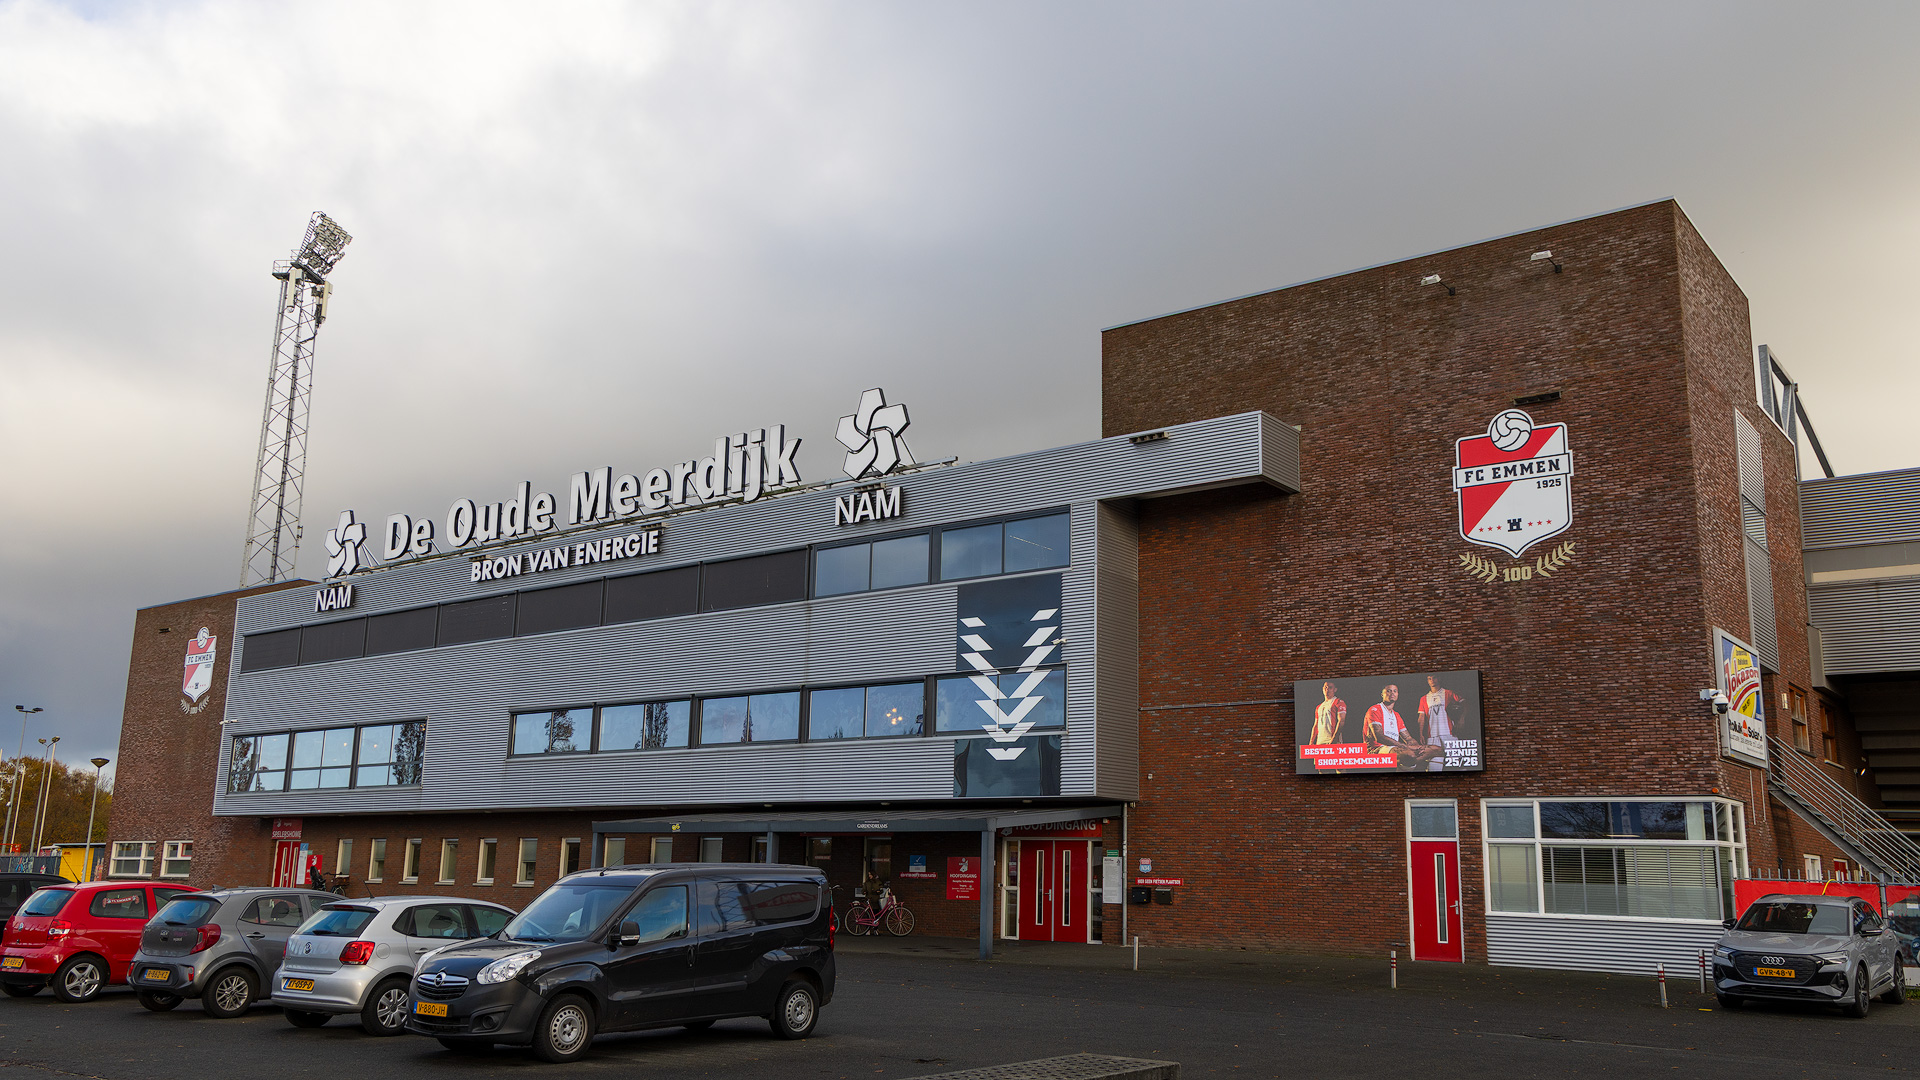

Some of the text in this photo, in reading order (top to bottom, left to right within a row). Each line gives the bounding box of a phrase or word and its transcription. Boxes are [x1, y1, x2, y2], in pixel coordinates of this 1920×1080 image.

[1464, 458, 1561, 483] FC EMMEN
[1536, 478, 1562, 489] 1925
[384, 424, 802, 560] De Oude Meerdijk
[835, 487, 904, 527] NAM
[471, 530, 661, 583] BRON VAN ENERGIE
[1502, 565, 1532, 582] 100
[314, 586, 356, 612] NAM
[1444, 739, 1478, 748] THUIS
[1444, 749, 1478, 757] TENUE
[1318, 757, 1394, 766] SHOP.FCEMMEN.NL
[1444, 757, 1478, 767] 25/26
[272, 830, 302, 838] SPELERSHOME
[1759, 968, 1793, 977] GVR-48-V
[418, 1003, 446, 1015] V-880-JH
